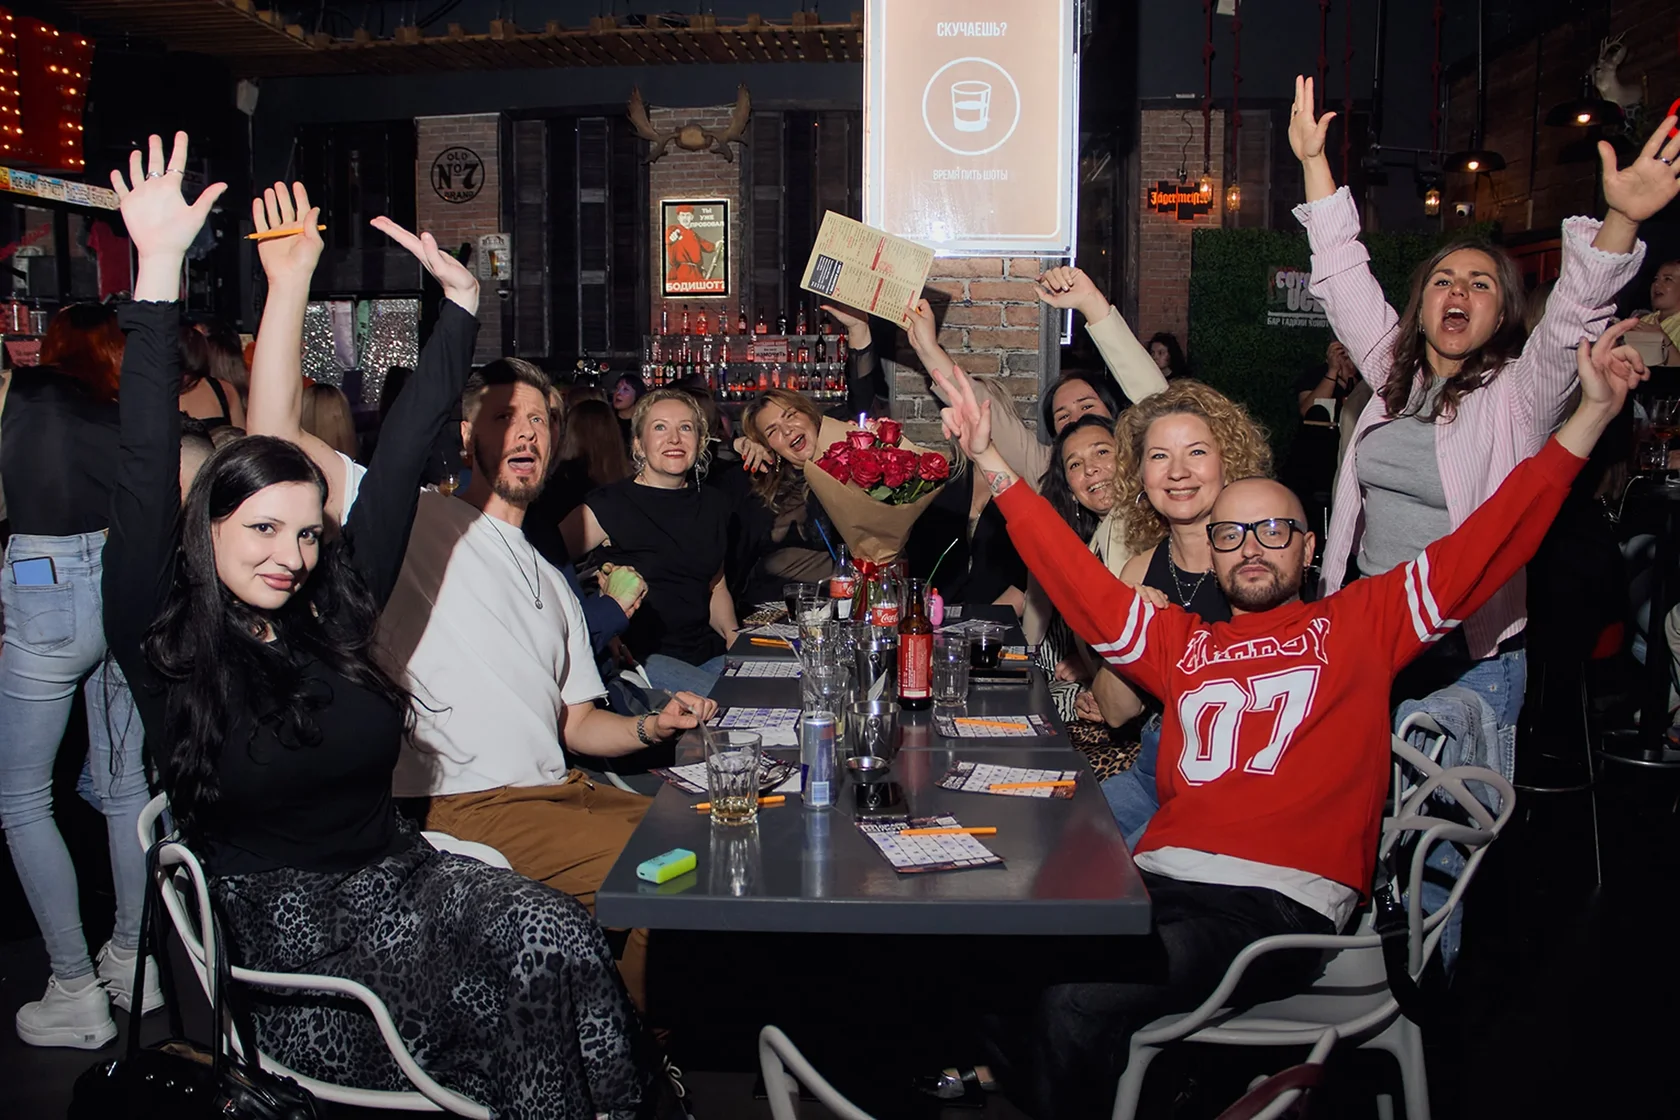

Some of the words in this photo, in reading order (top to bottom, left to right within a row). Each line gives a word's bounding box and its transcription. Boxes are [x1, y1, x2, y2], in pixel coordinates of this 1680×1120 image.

[937, 21, 1008, 37] СКУЧАЕШЬ?
[446, 152, 468, 161] OLD
[932, 169, 960, 180] ВРЕМЯ
[961, 169, 982, 180] ПИТЬ
[983, 169, 1008, 180] ШОТЫ
[690, 220, 725, 228] ПРОБОВАЛ
[1276, 271, 1312, 289] COYO
[1287, 288, 1324, 312] UGL
[1267, 317, 1280, 325] БАР
[1177, 665, 1321, 787] 07
